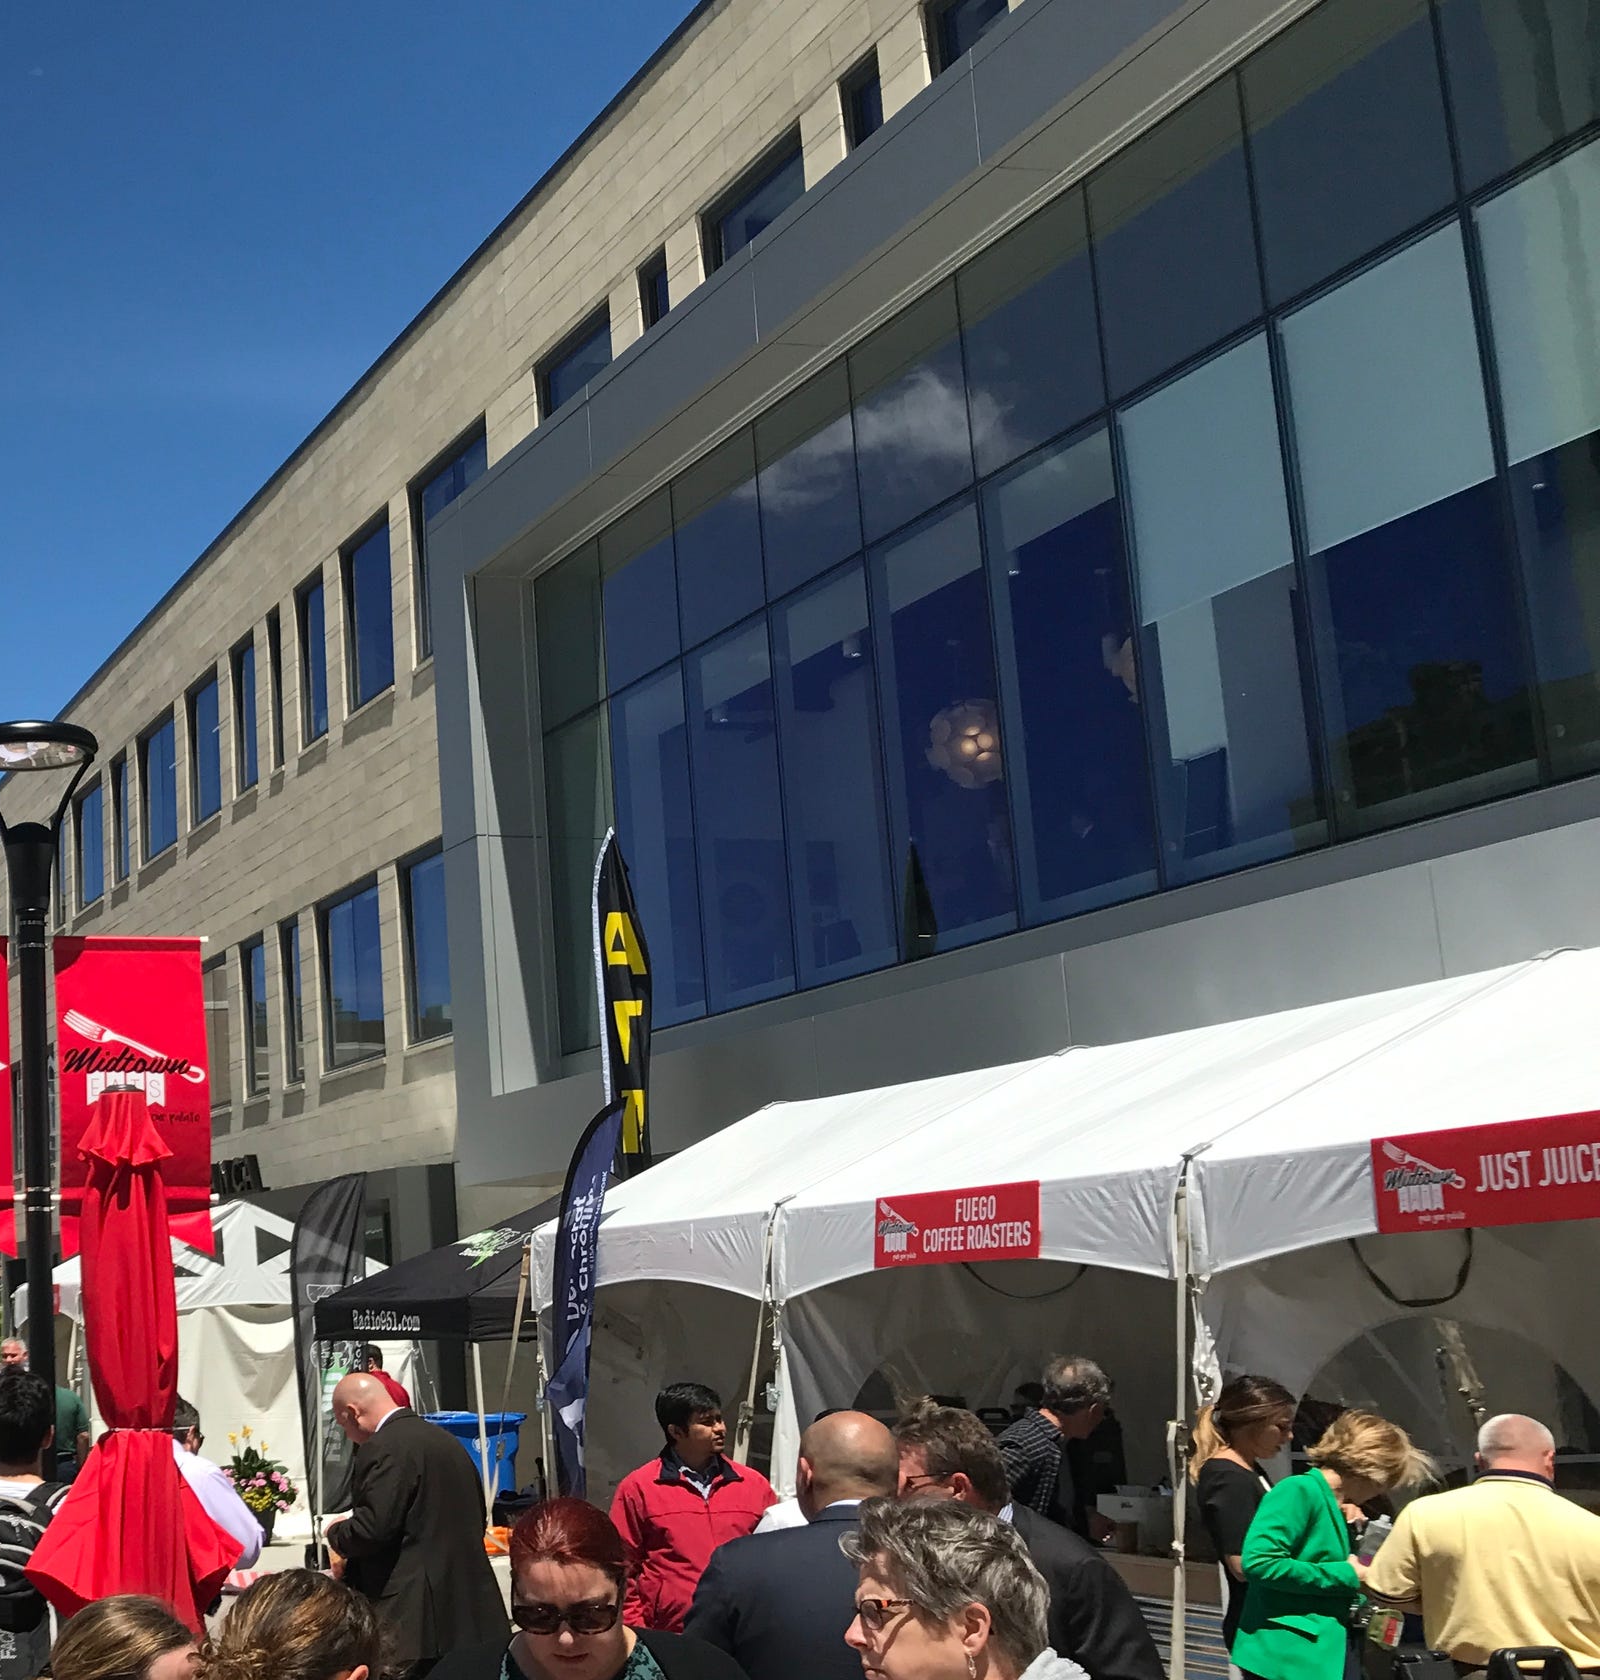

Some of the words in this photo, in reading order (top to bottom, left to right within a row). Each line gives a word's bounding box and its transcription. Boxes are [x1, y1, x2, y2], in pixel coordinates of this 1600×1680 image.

[63, 1046, 191, 1074] Midtown
[1384, 1166, 1456, 1191] Midtown
[1475, 1150, 1532, 1193] JUST
[1538, 1142, 1600, 1187] JUICE
[955, 1195, 996, 1223] FUEGO
[923, 1226, 965, 1253] COFFEE
[967, 1220, 1031, 1250] ROASTERS
[353, 1309, 421, 1332] Radio951.com
[0, 1628, 17, 1660] FAC
